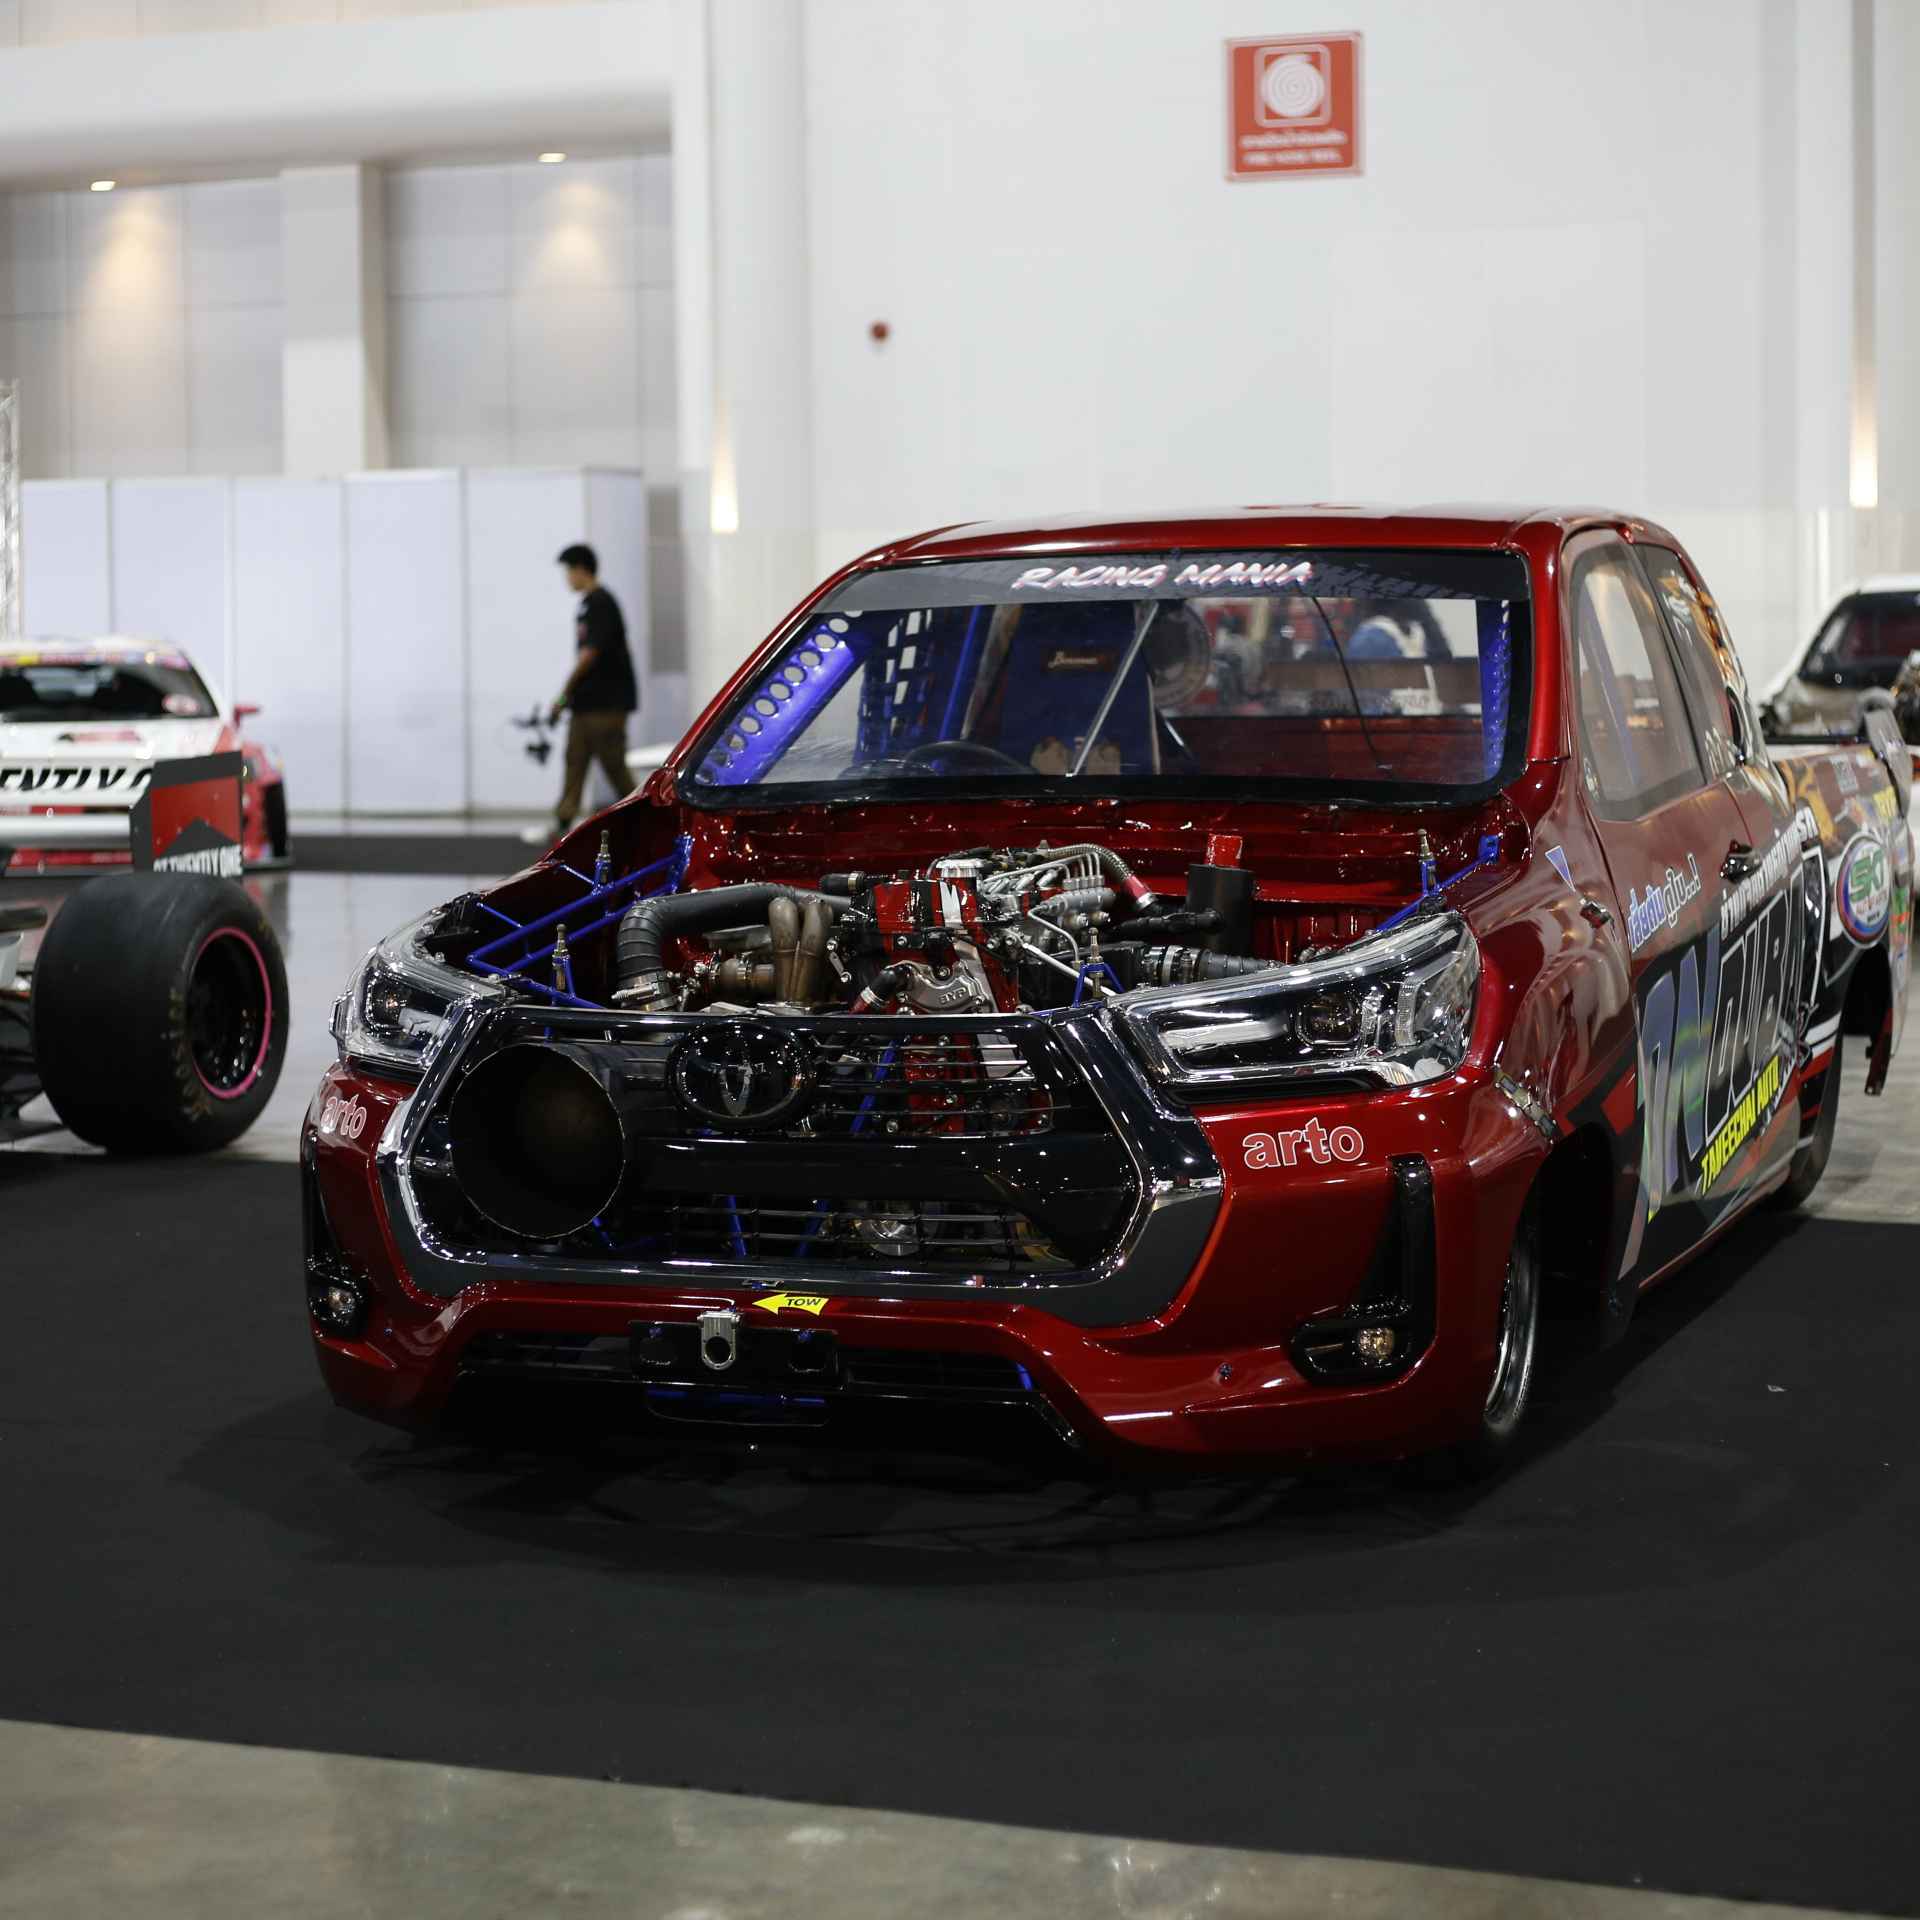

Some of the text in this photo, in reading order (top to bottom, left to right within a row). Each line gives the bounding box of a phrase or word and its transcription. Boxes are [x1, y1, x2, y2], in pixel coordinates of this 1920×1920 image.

[1011, 561, 1313, 589] RACING MANIA
[320, 1094, 367, 1139] arto
[1242, 1117, 1364, 1170] arto
[786, 1298, 822, 1307] TOW
